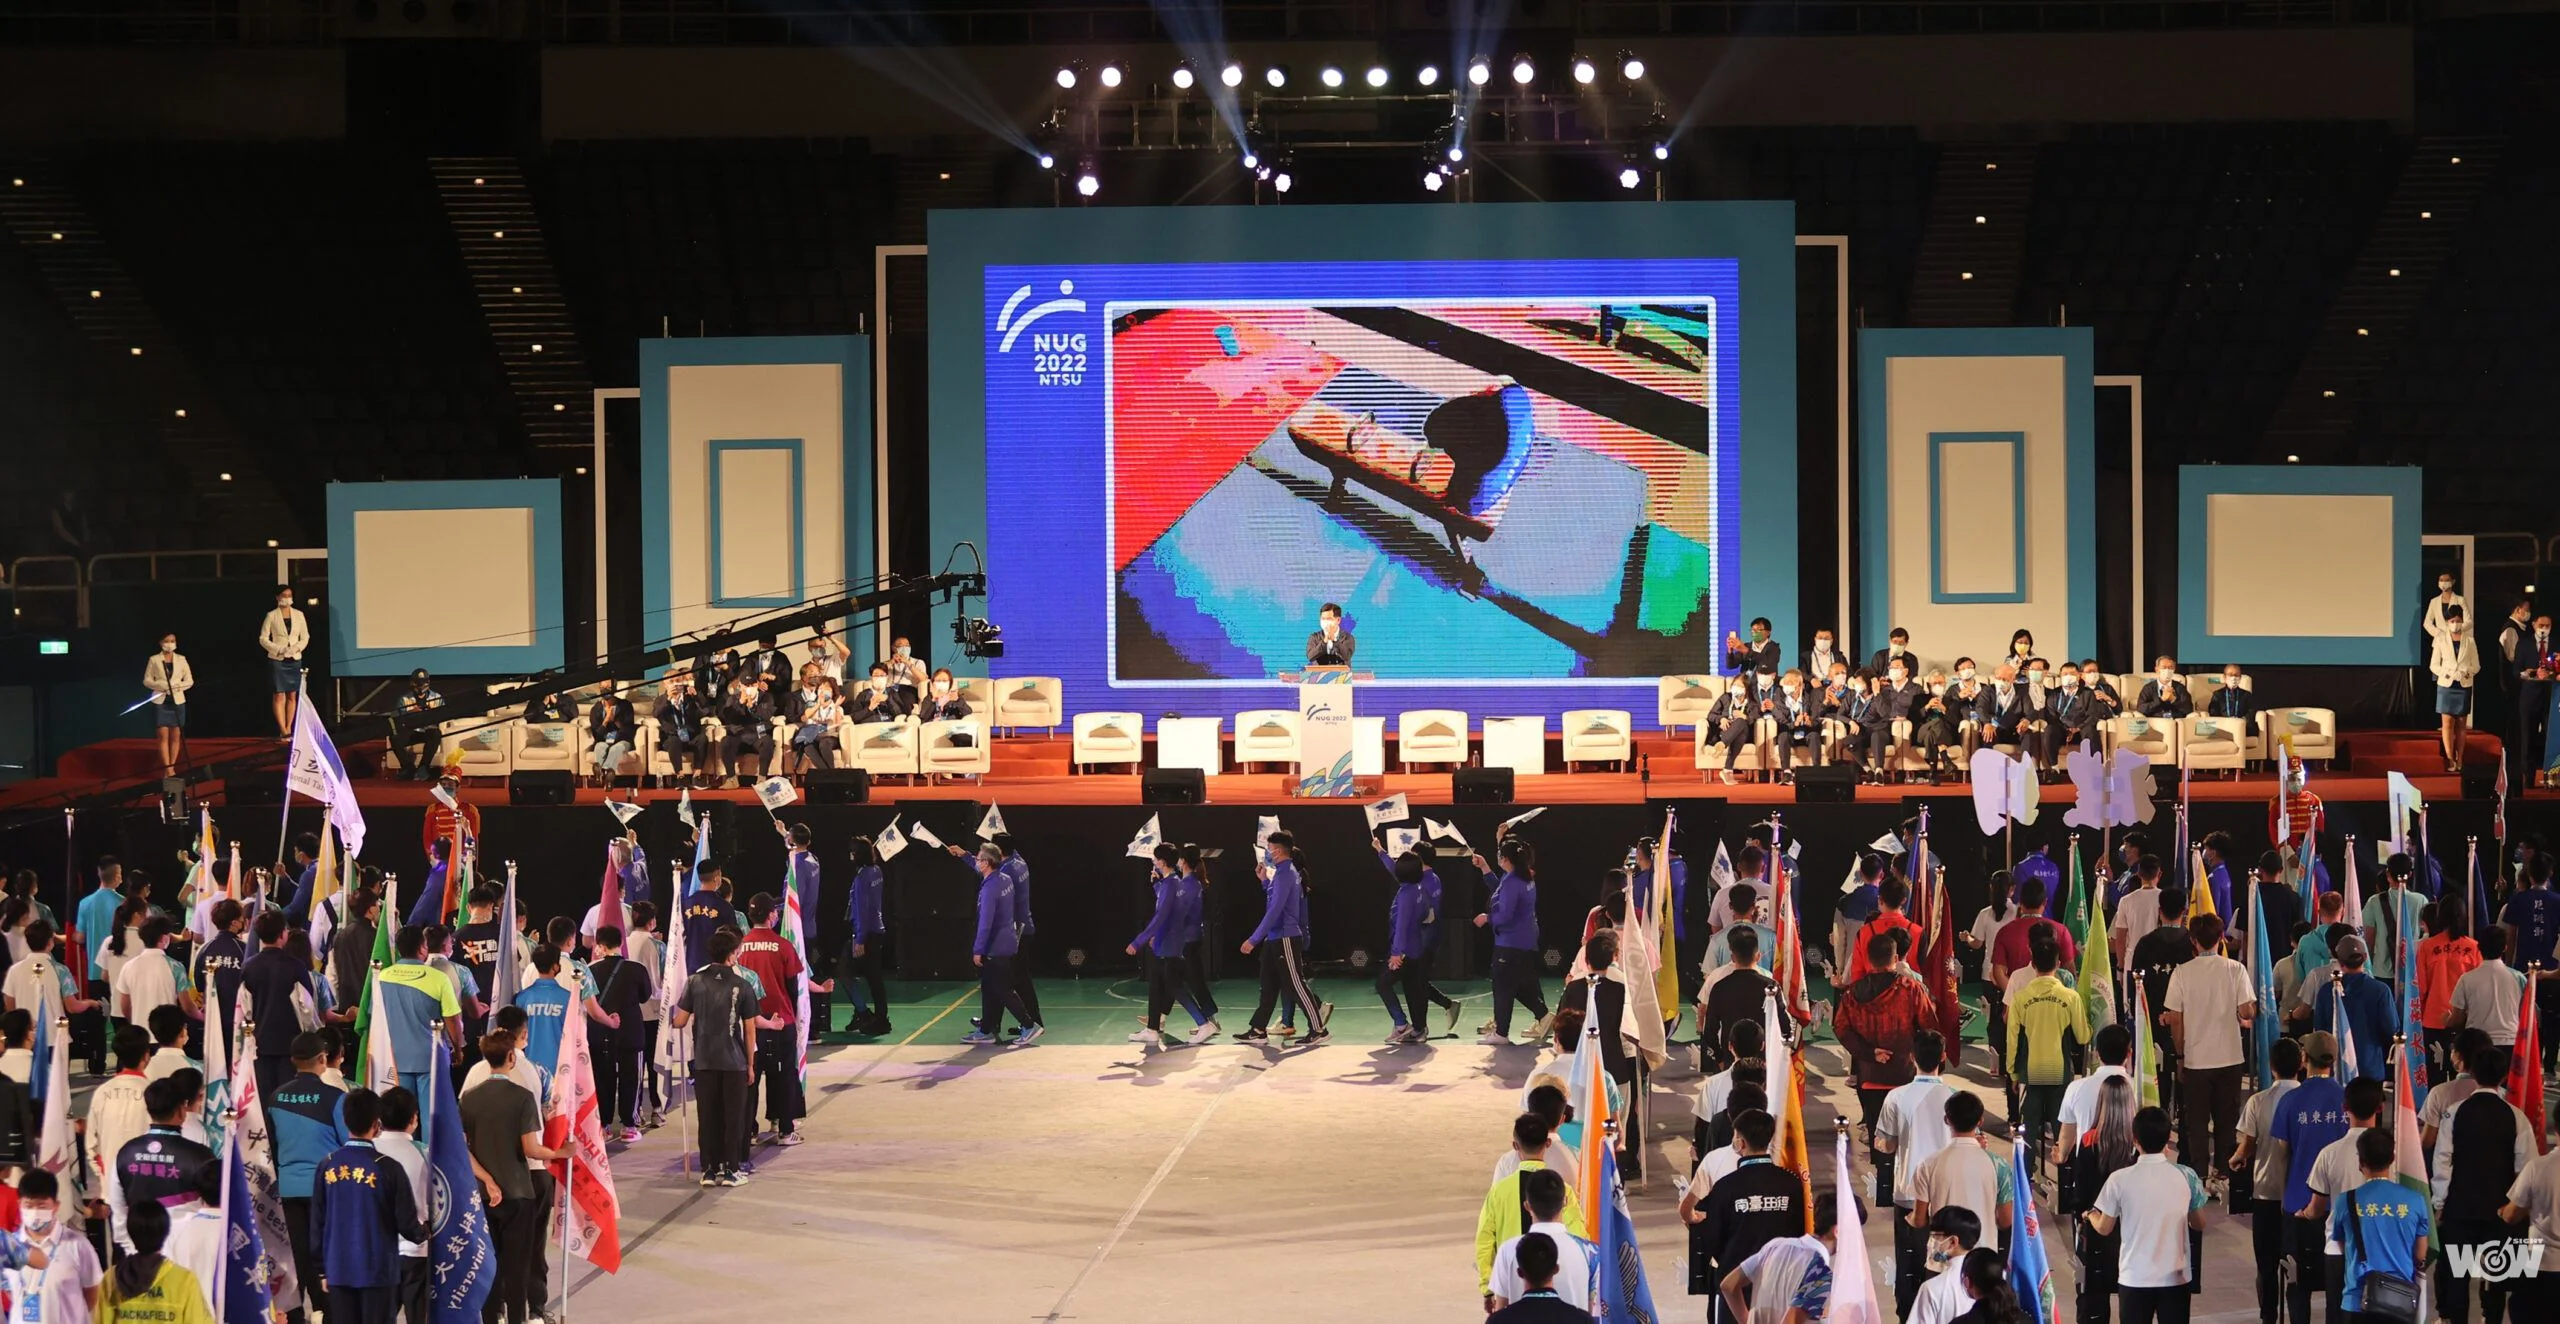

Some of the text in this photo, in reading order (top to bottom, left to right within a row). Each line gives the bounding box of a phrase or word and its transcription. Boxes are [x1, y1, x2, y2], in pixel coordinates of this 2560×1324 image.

[1034, 333, 1087, 352] NUG
[1034, 354, 1087, 372] 2022
[1039, 374, 1082, 386] NTSU
[527, 1004, 562, 1017] NTUS
[104, 1088, 144, 1101] NTTU
[277, 1093, 320, 1104] 國立高雄大學
[2298, 1110, 2350, 1124] 嶺東科大
